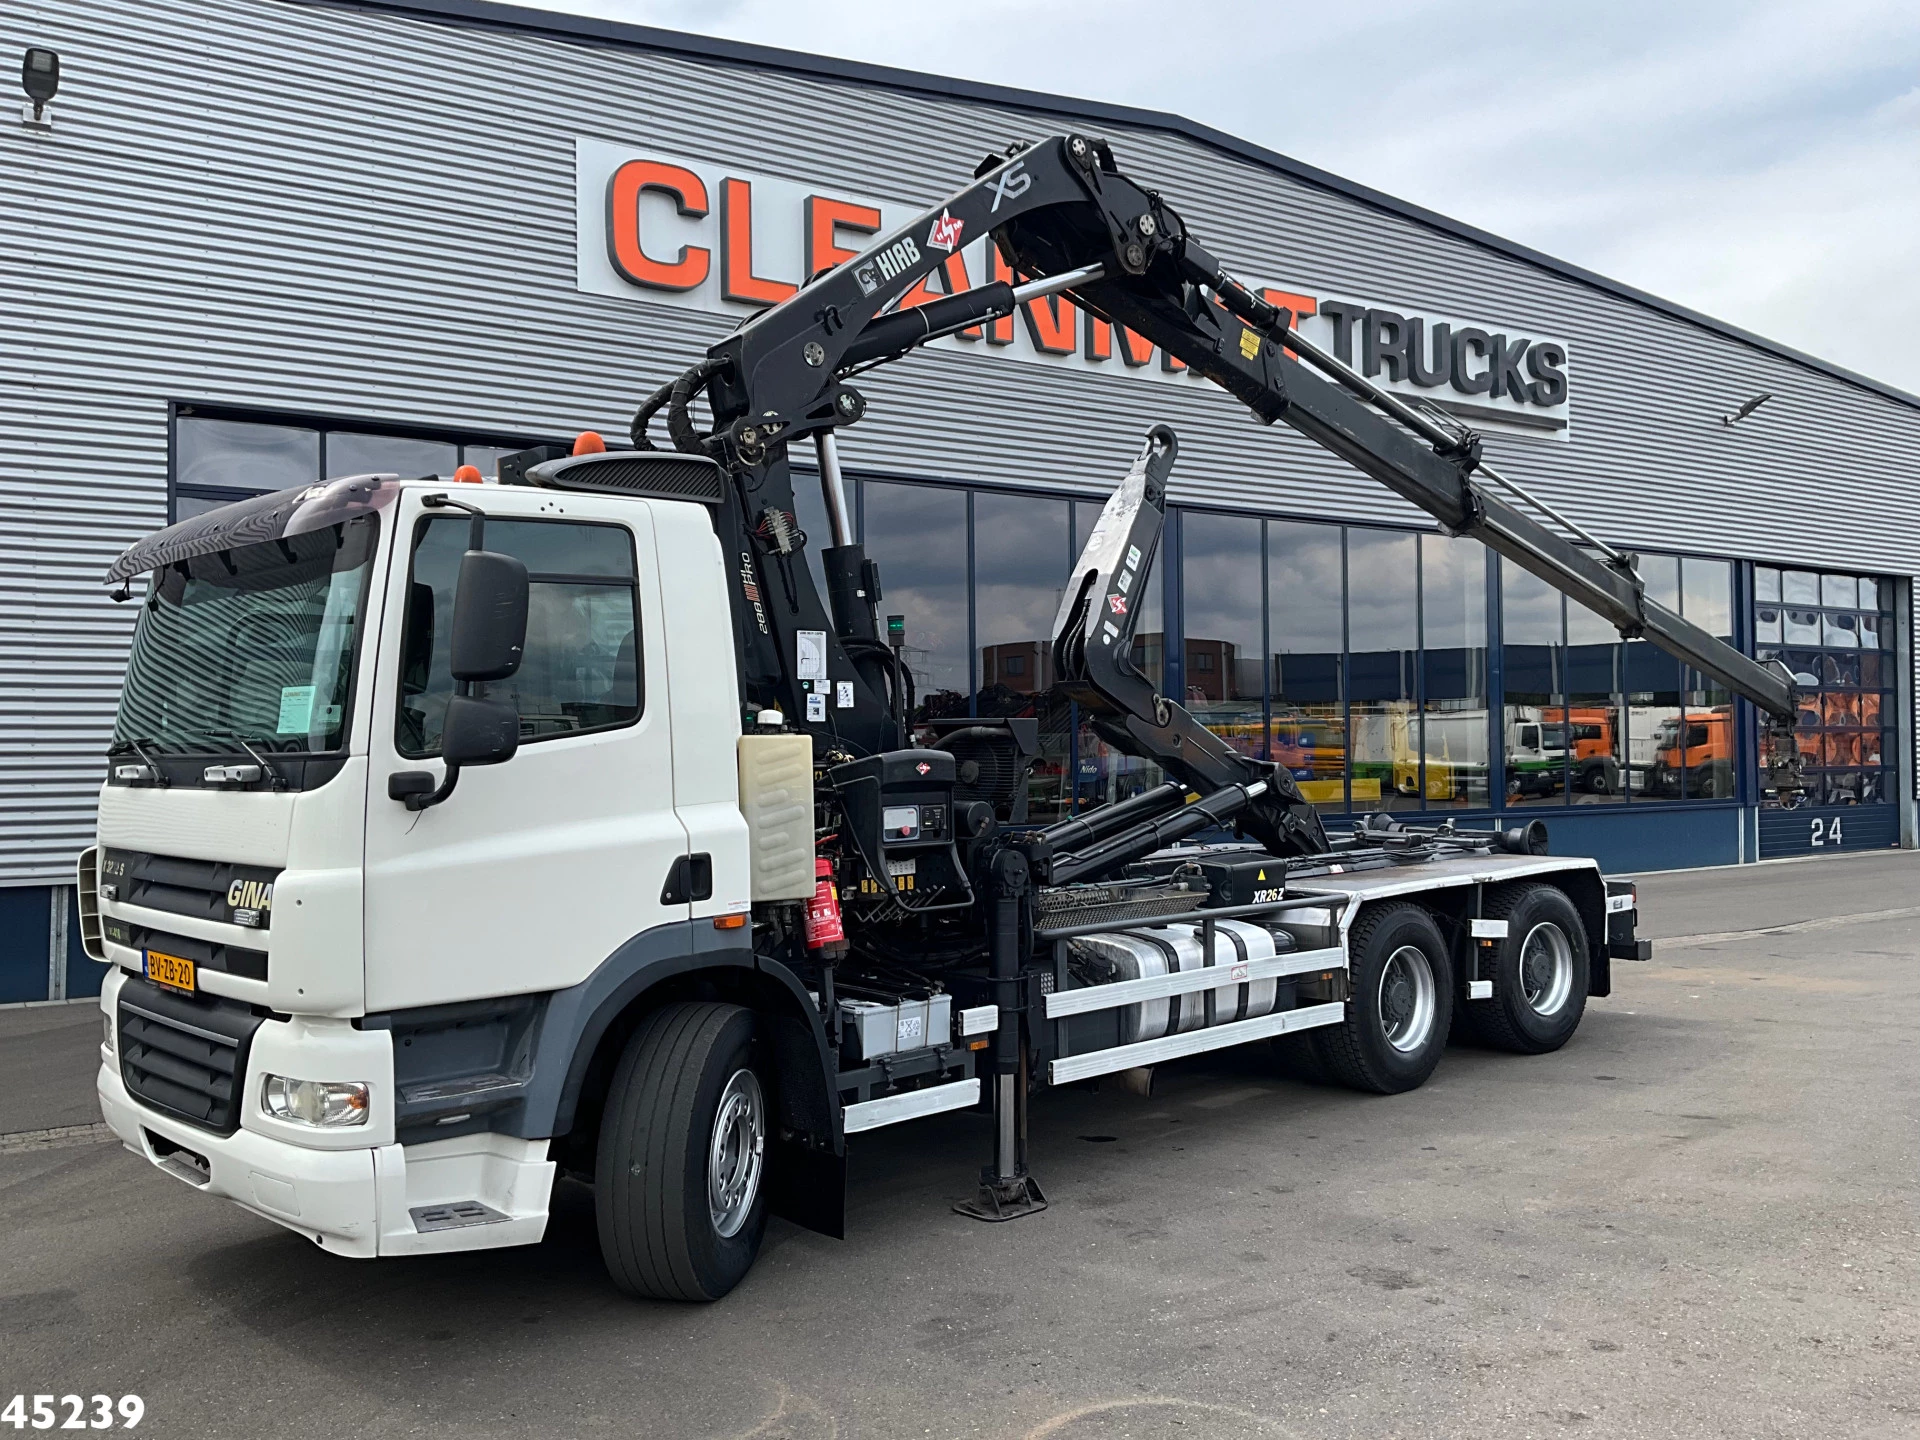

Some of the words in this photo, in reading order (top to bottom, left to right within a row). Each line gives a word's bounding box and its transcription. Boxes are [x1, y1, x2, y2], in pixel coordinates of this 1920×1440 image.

[983, 160, 1031, 213] XS
[874, 236, 922, 282] HIAB
[604, 159, 1318, 376] CLEANT
[1319, 299, 1569, 407] TRUCKS
[753, 601, 768, 635] 288
[1079, 765, 1098, 774] Nido
[1811, 816, 1843, 847] 24
[227, 879, 274, 911] GINA
[1252, 887, 1285, 904] XR26Z
[149, 954, 191, 986] BV-ZB-20
